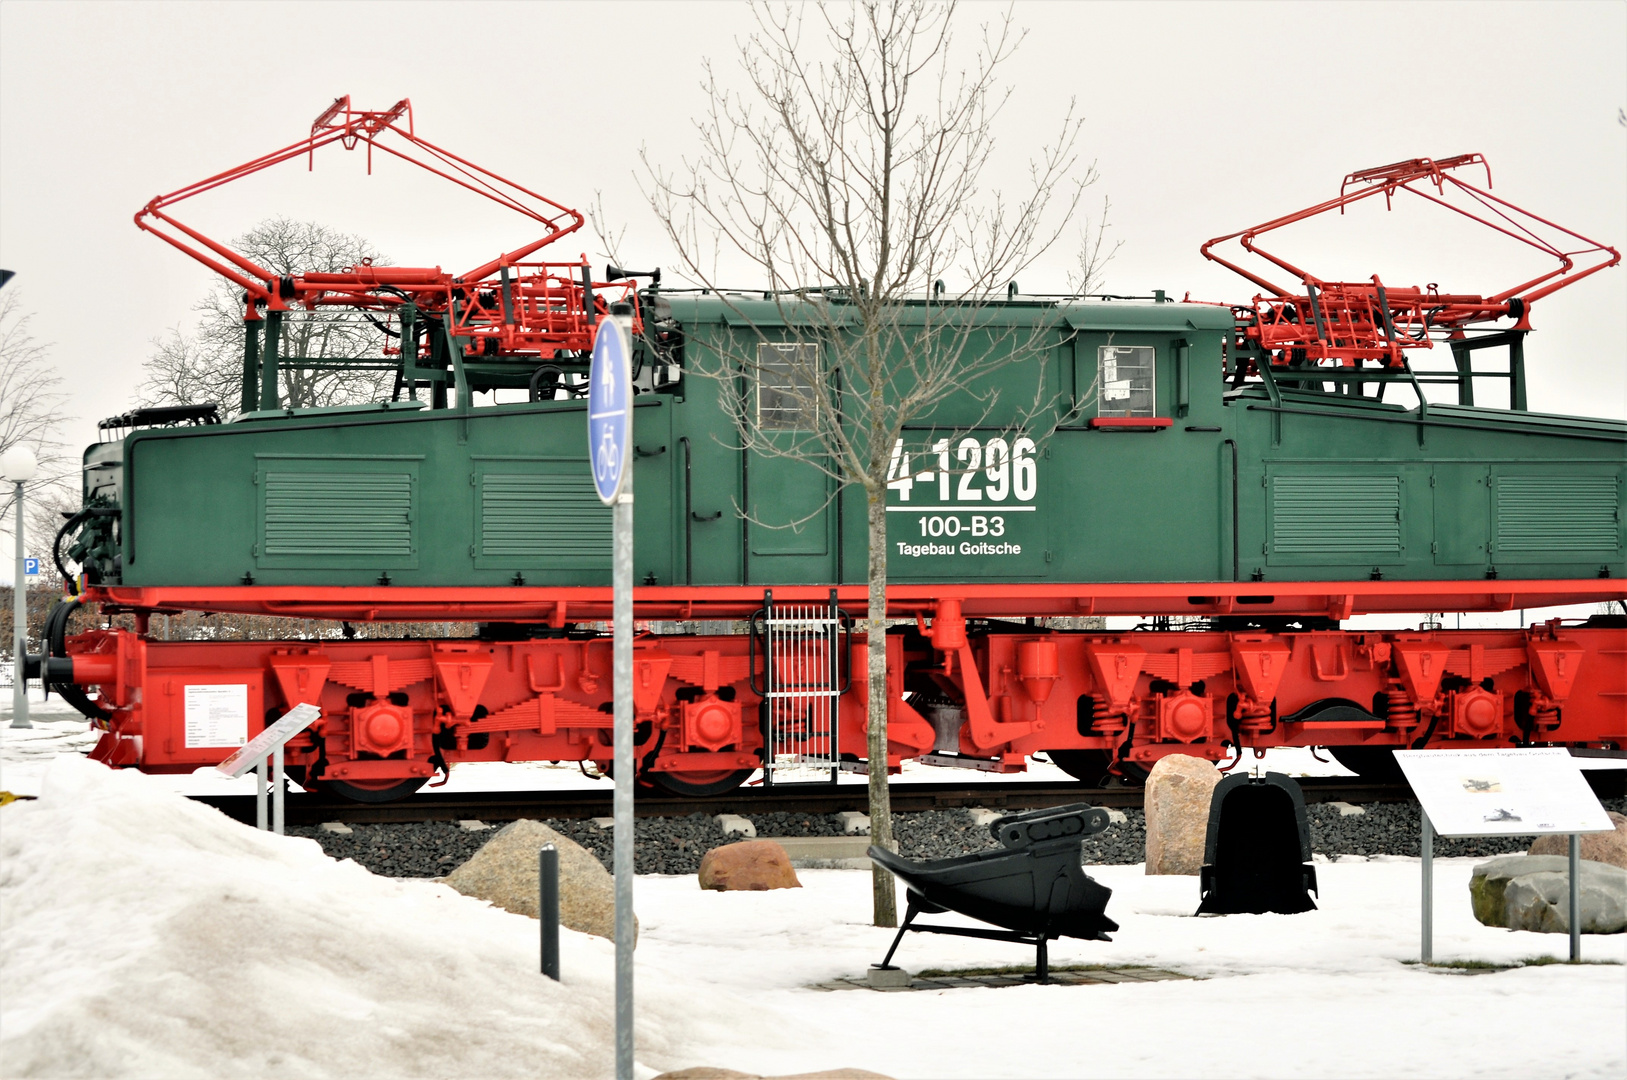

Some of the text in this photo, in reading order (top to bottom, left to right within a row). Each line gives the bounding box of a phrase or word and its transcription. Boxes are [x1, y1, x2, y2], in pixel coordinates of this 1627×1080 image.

[886, 437, 1037, 502] 4-1296
[918, 516, 1005, 537] 100-B3
[896, 542, 1022, 557] Tagebau Goitsche
[26, 560, 36, 573] P
